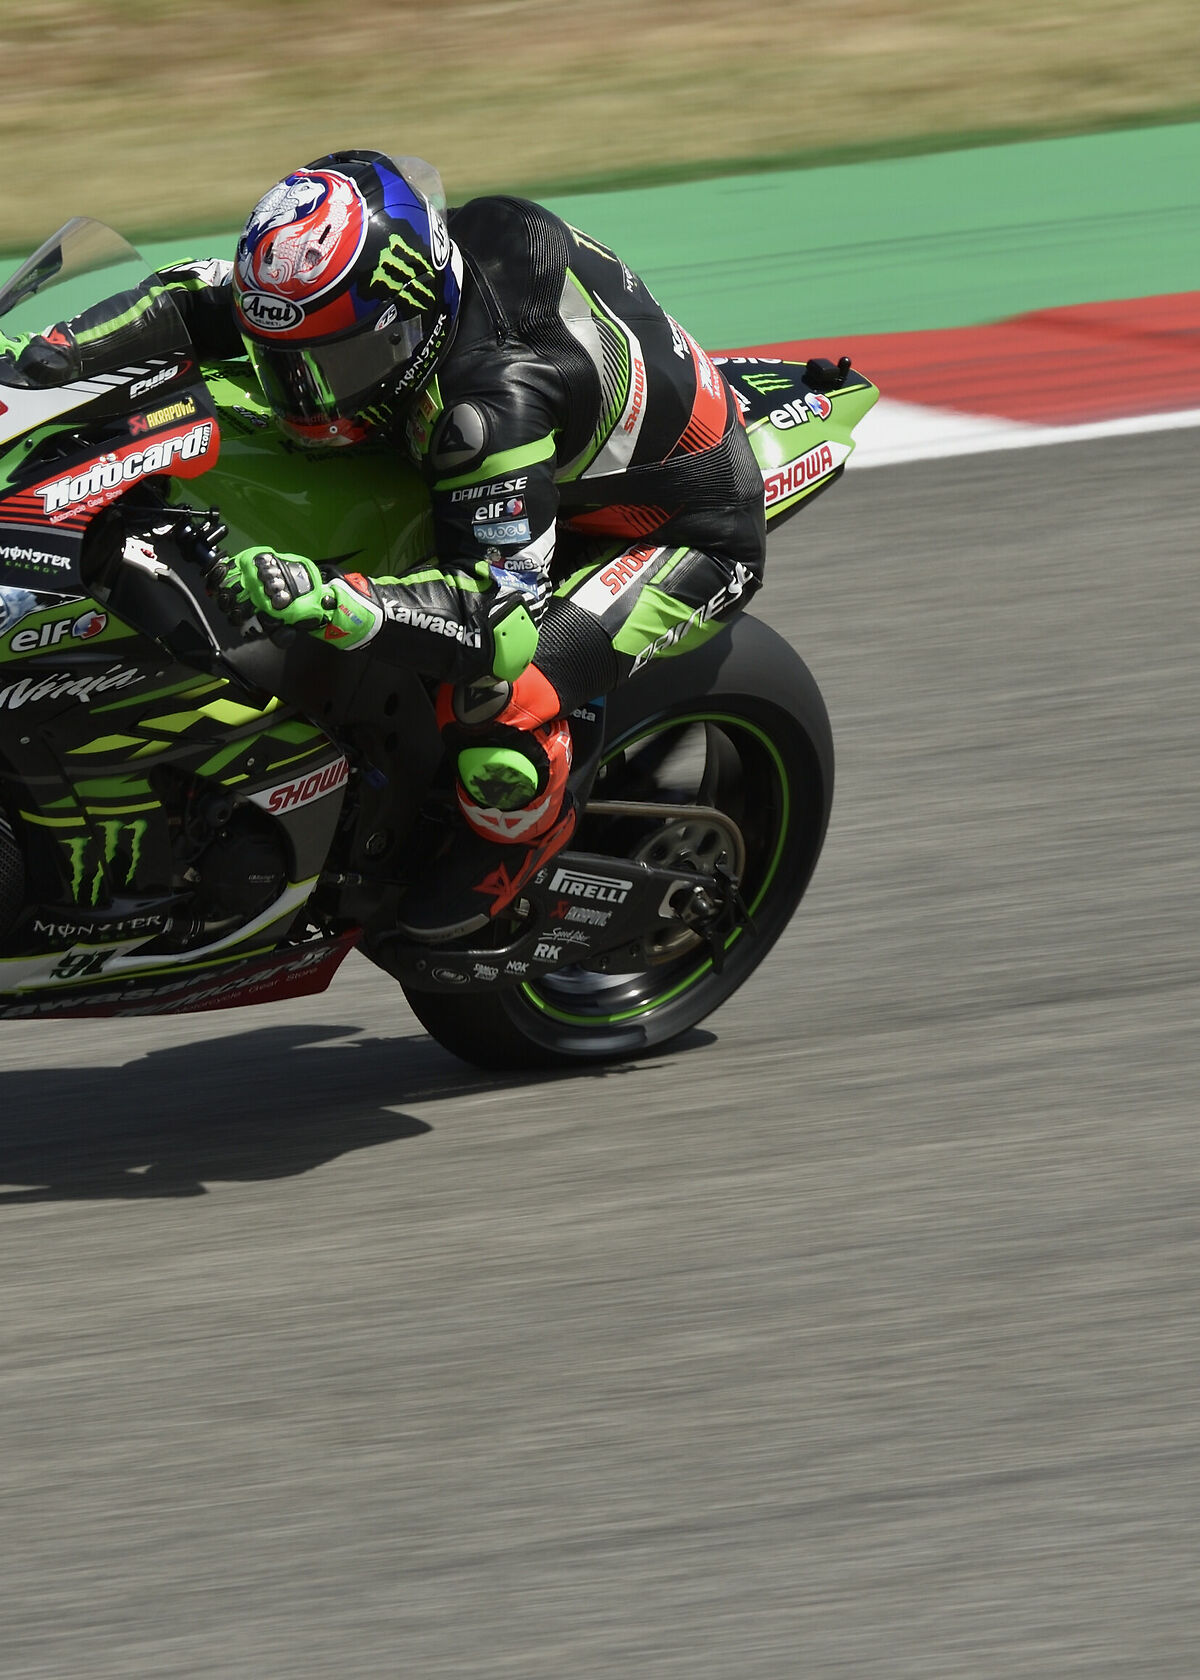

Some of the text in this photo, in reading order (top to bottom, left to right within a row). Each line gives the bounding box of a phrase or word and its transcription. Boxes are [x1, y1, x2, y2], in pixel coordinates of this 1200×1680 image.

[244, 296, 293, 321] Arai
[395, 313, 447, 394] MONSTER
[623, 358, 645, 434] SHOWA
[769, 399, 809, 430] elf
[451, 476, 528, 502] DAINESE
[765, 445, 833, 502] SHOWA
[50, 489, 123, 524] Motorcycle Gear Store
[475, 501, 504, 520] elf
[4, 561, 59, 575] ENERGY
[600, 545, 657, 595] SHOW
[10, 619, 73, 652] elf
[382, 597, 482, 649] Kawasaki
[570, 708, 596, 722] eta
[266, 761, 349, 812] SHOWA
[548, 867, 634, 904] PIRELLI
[49, 949, 118, 979] 91
[506, 960, 530, 973] NGK
[533, 943, 563, 960] RK
